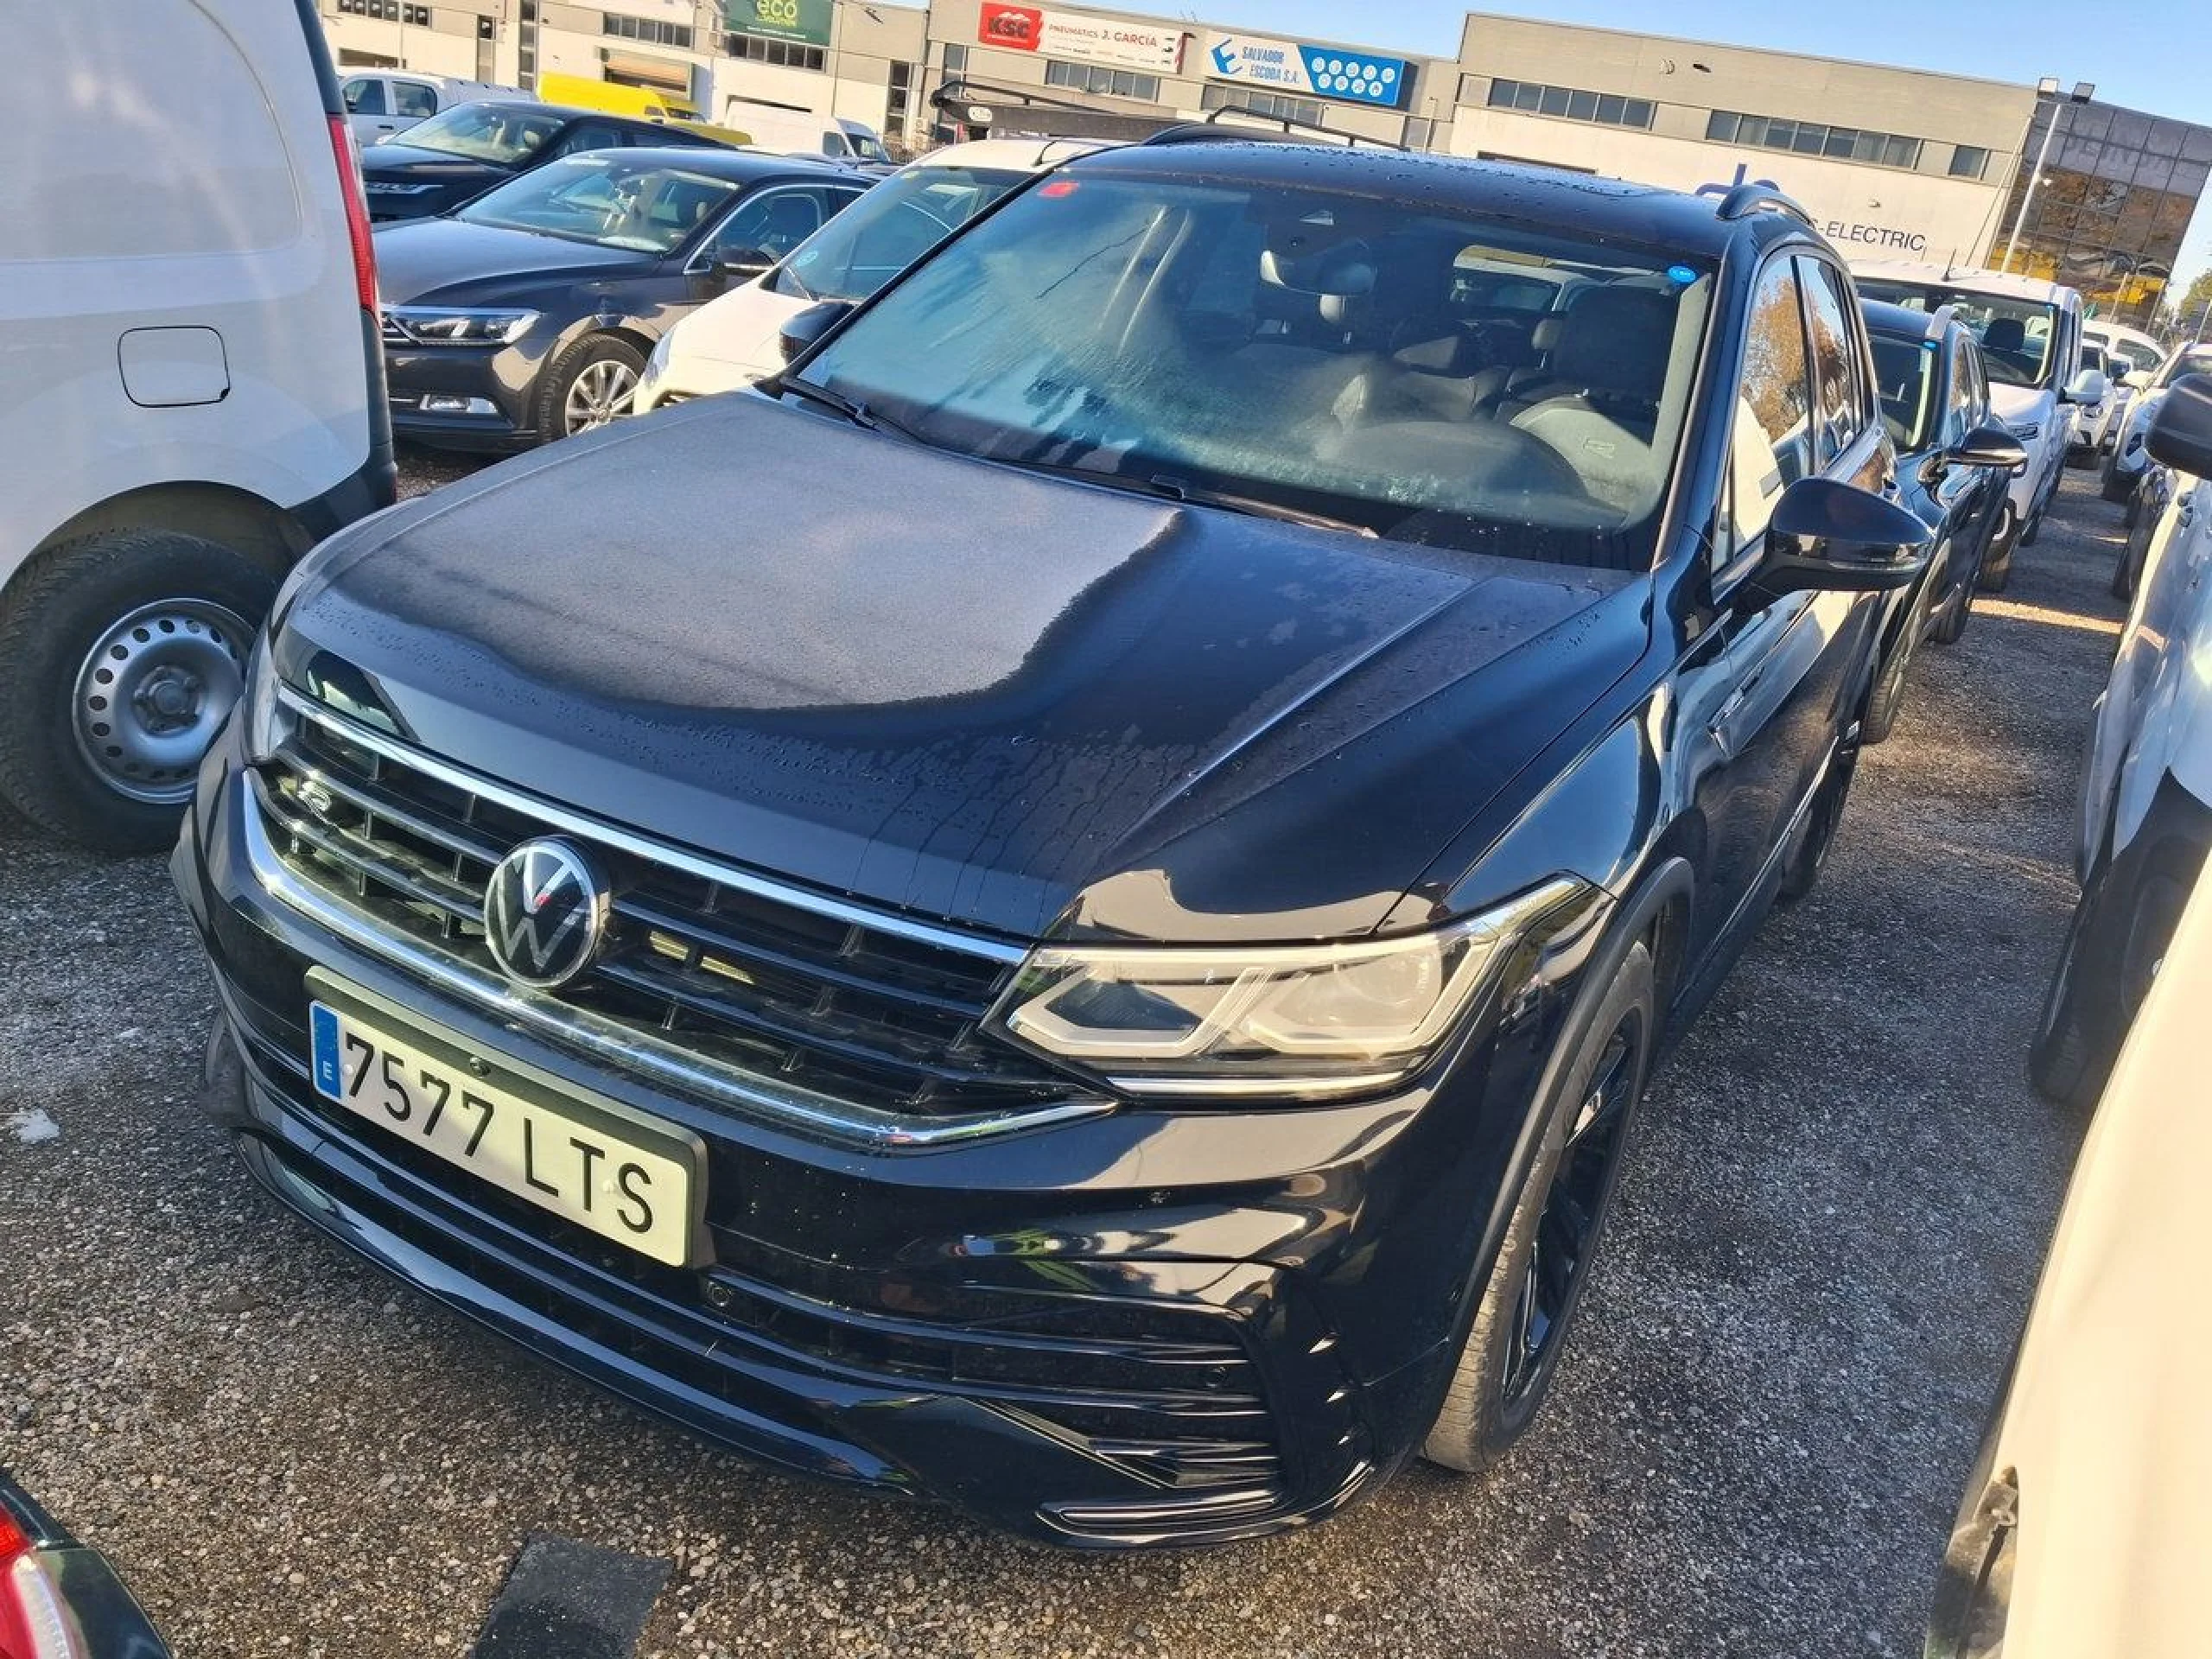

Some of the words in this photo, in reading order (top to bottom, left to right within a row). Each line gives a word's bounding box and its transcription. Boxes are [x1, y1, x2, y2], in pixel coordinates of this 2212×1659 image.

[988, 17, 1029, 38] KSC
[1048, 24, 1098, 38] PNEUMATICS
[1102, 29, 1110, 40] J.
[1242, 46, 1285, 65] SALVADOR
[322, 1060, 333, 1081] E
[345, 1031, 496, 1157] 7577
[523, 1116, 653, 1234] LTS
